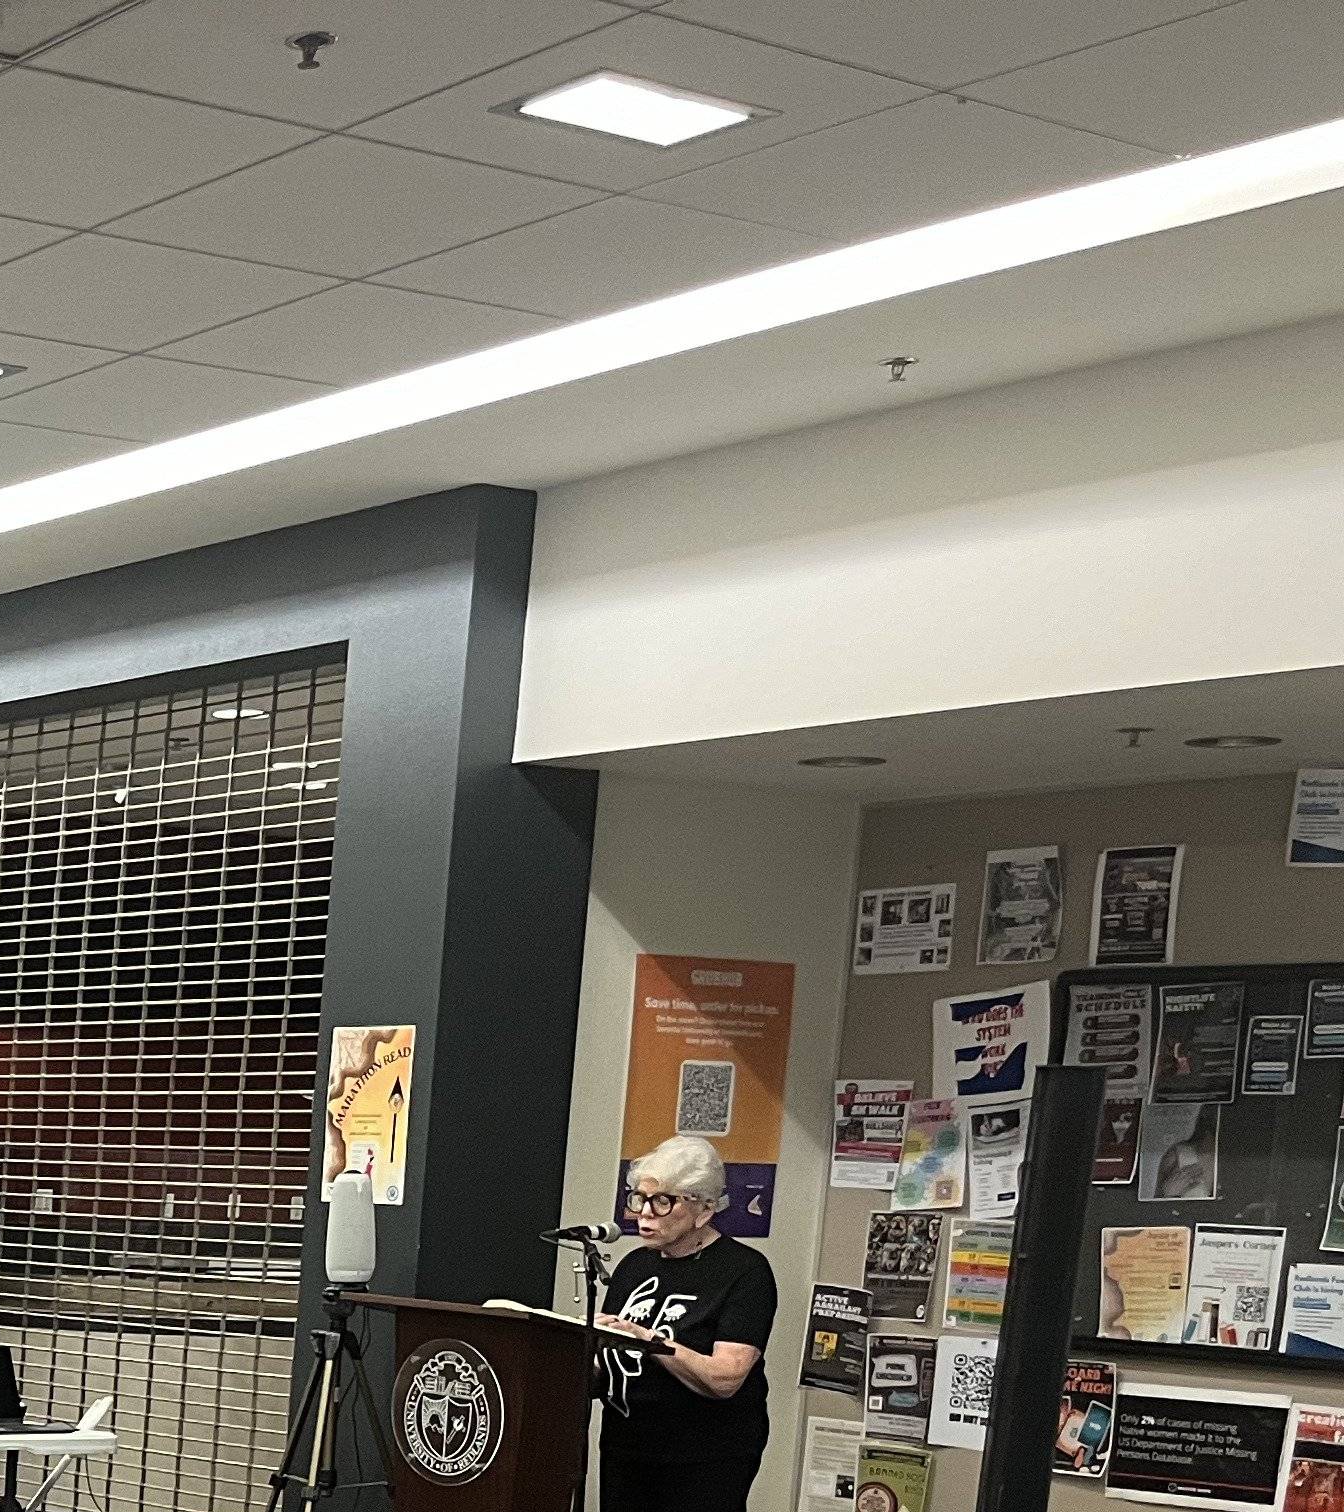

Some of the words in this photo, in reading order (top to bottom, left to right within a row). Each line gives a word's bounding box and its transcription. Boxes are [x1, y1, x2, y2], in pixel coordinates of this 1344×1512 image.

[645, 997, 670, 1009] Save
[335, 1058, 382, 1126] MARATHON
[383, 1046, 412, 1066] READ
[1243, 1240, 1278, 1251] Corner
[815, 1293, 849, 1305] ACTIVE
[1067, 1367, 1101, 1380] OARD
[1120, 1413, 1140, 1425] Only
[1141, 1415, 1156, 1425] 2%
[1157, 1416, 1167, 1427] of
[1168, 1419, 1191, 1429] cases
[1192, 1418, 1203, 1430] of
[1204, 1422, 1238, 1435] missing
[405, 1401, 436, 1468] UNIVERSITY
[440, 1461, 454, 1472] OF
[457, 1414, 488, 1469] REDLANDS
[1120, 1427, 1145, 1437] Native
[1147, 1430, 1178, 1440] women
[1180, 1432, 1205, 1442] made
[1215, 1434, 1224, 1443] to
[1226, 1435, 1241, 1446] the
[1117, 1449, 1150, 1460] Persons
[1118, 1437, 1130, 1447] US
[1132, 1439, 1182, 1452] Department
[1185, 1442, 1195, 1453] of
[1196, 1445, 1223, 1456] Justice
[1225, 1447, 1257, 1462] Missing
